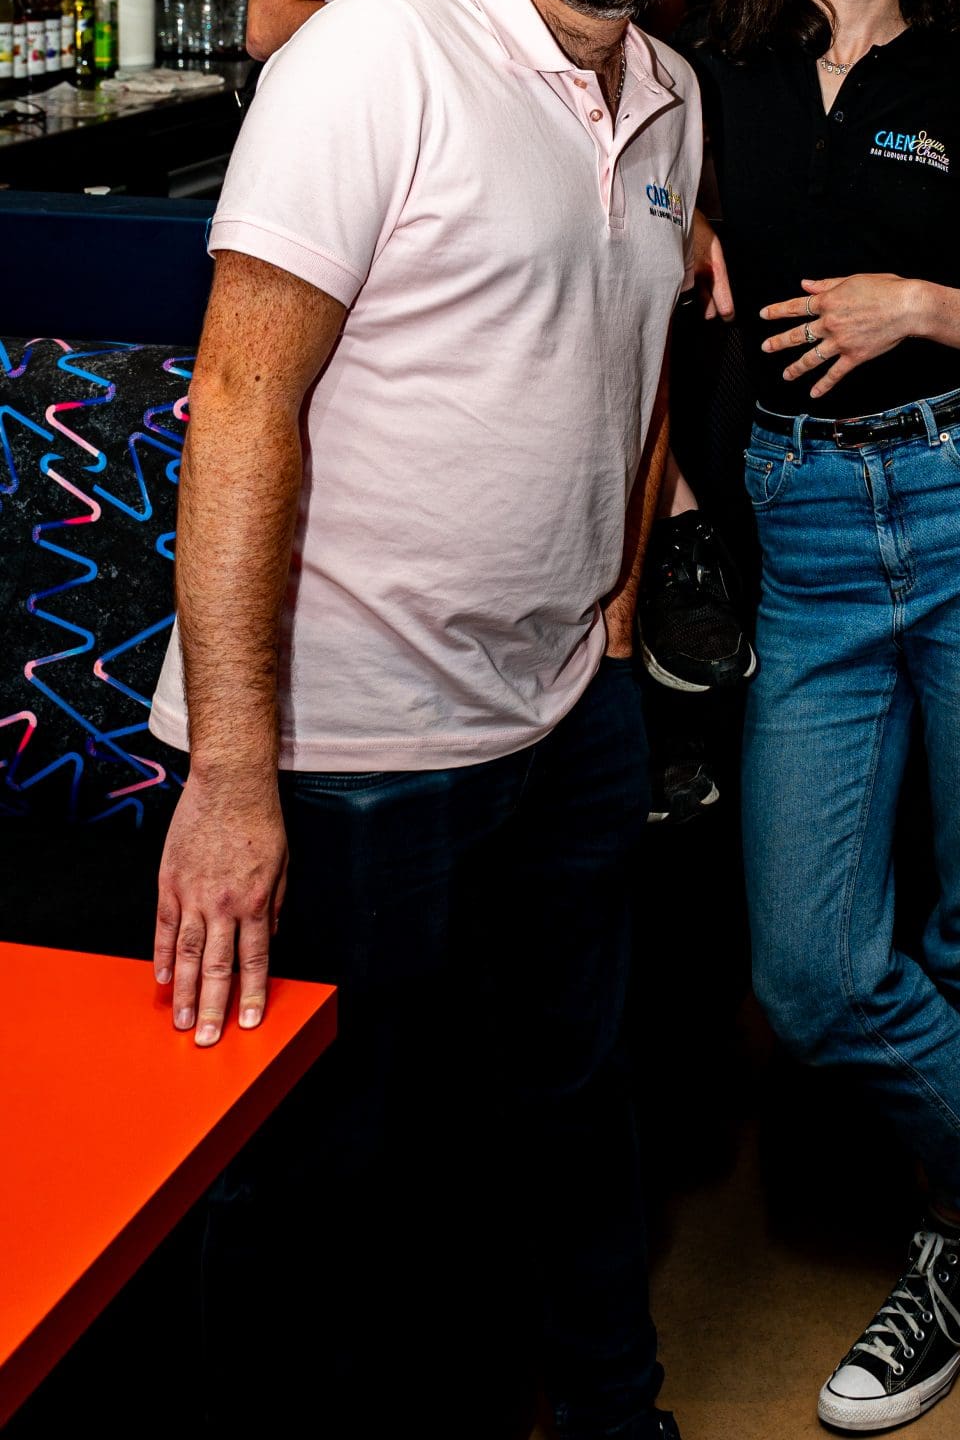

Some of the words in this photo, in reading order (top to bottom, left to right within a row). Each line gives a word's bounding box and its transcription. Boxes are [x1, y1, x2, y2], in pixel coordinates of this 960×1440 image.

[875, 130, 917, 152] CAEN
[869, 147, 882, 156] BAR
[883, 149, 908, 162] LUDIQUE
[916, 145, 950, 166] Chante
